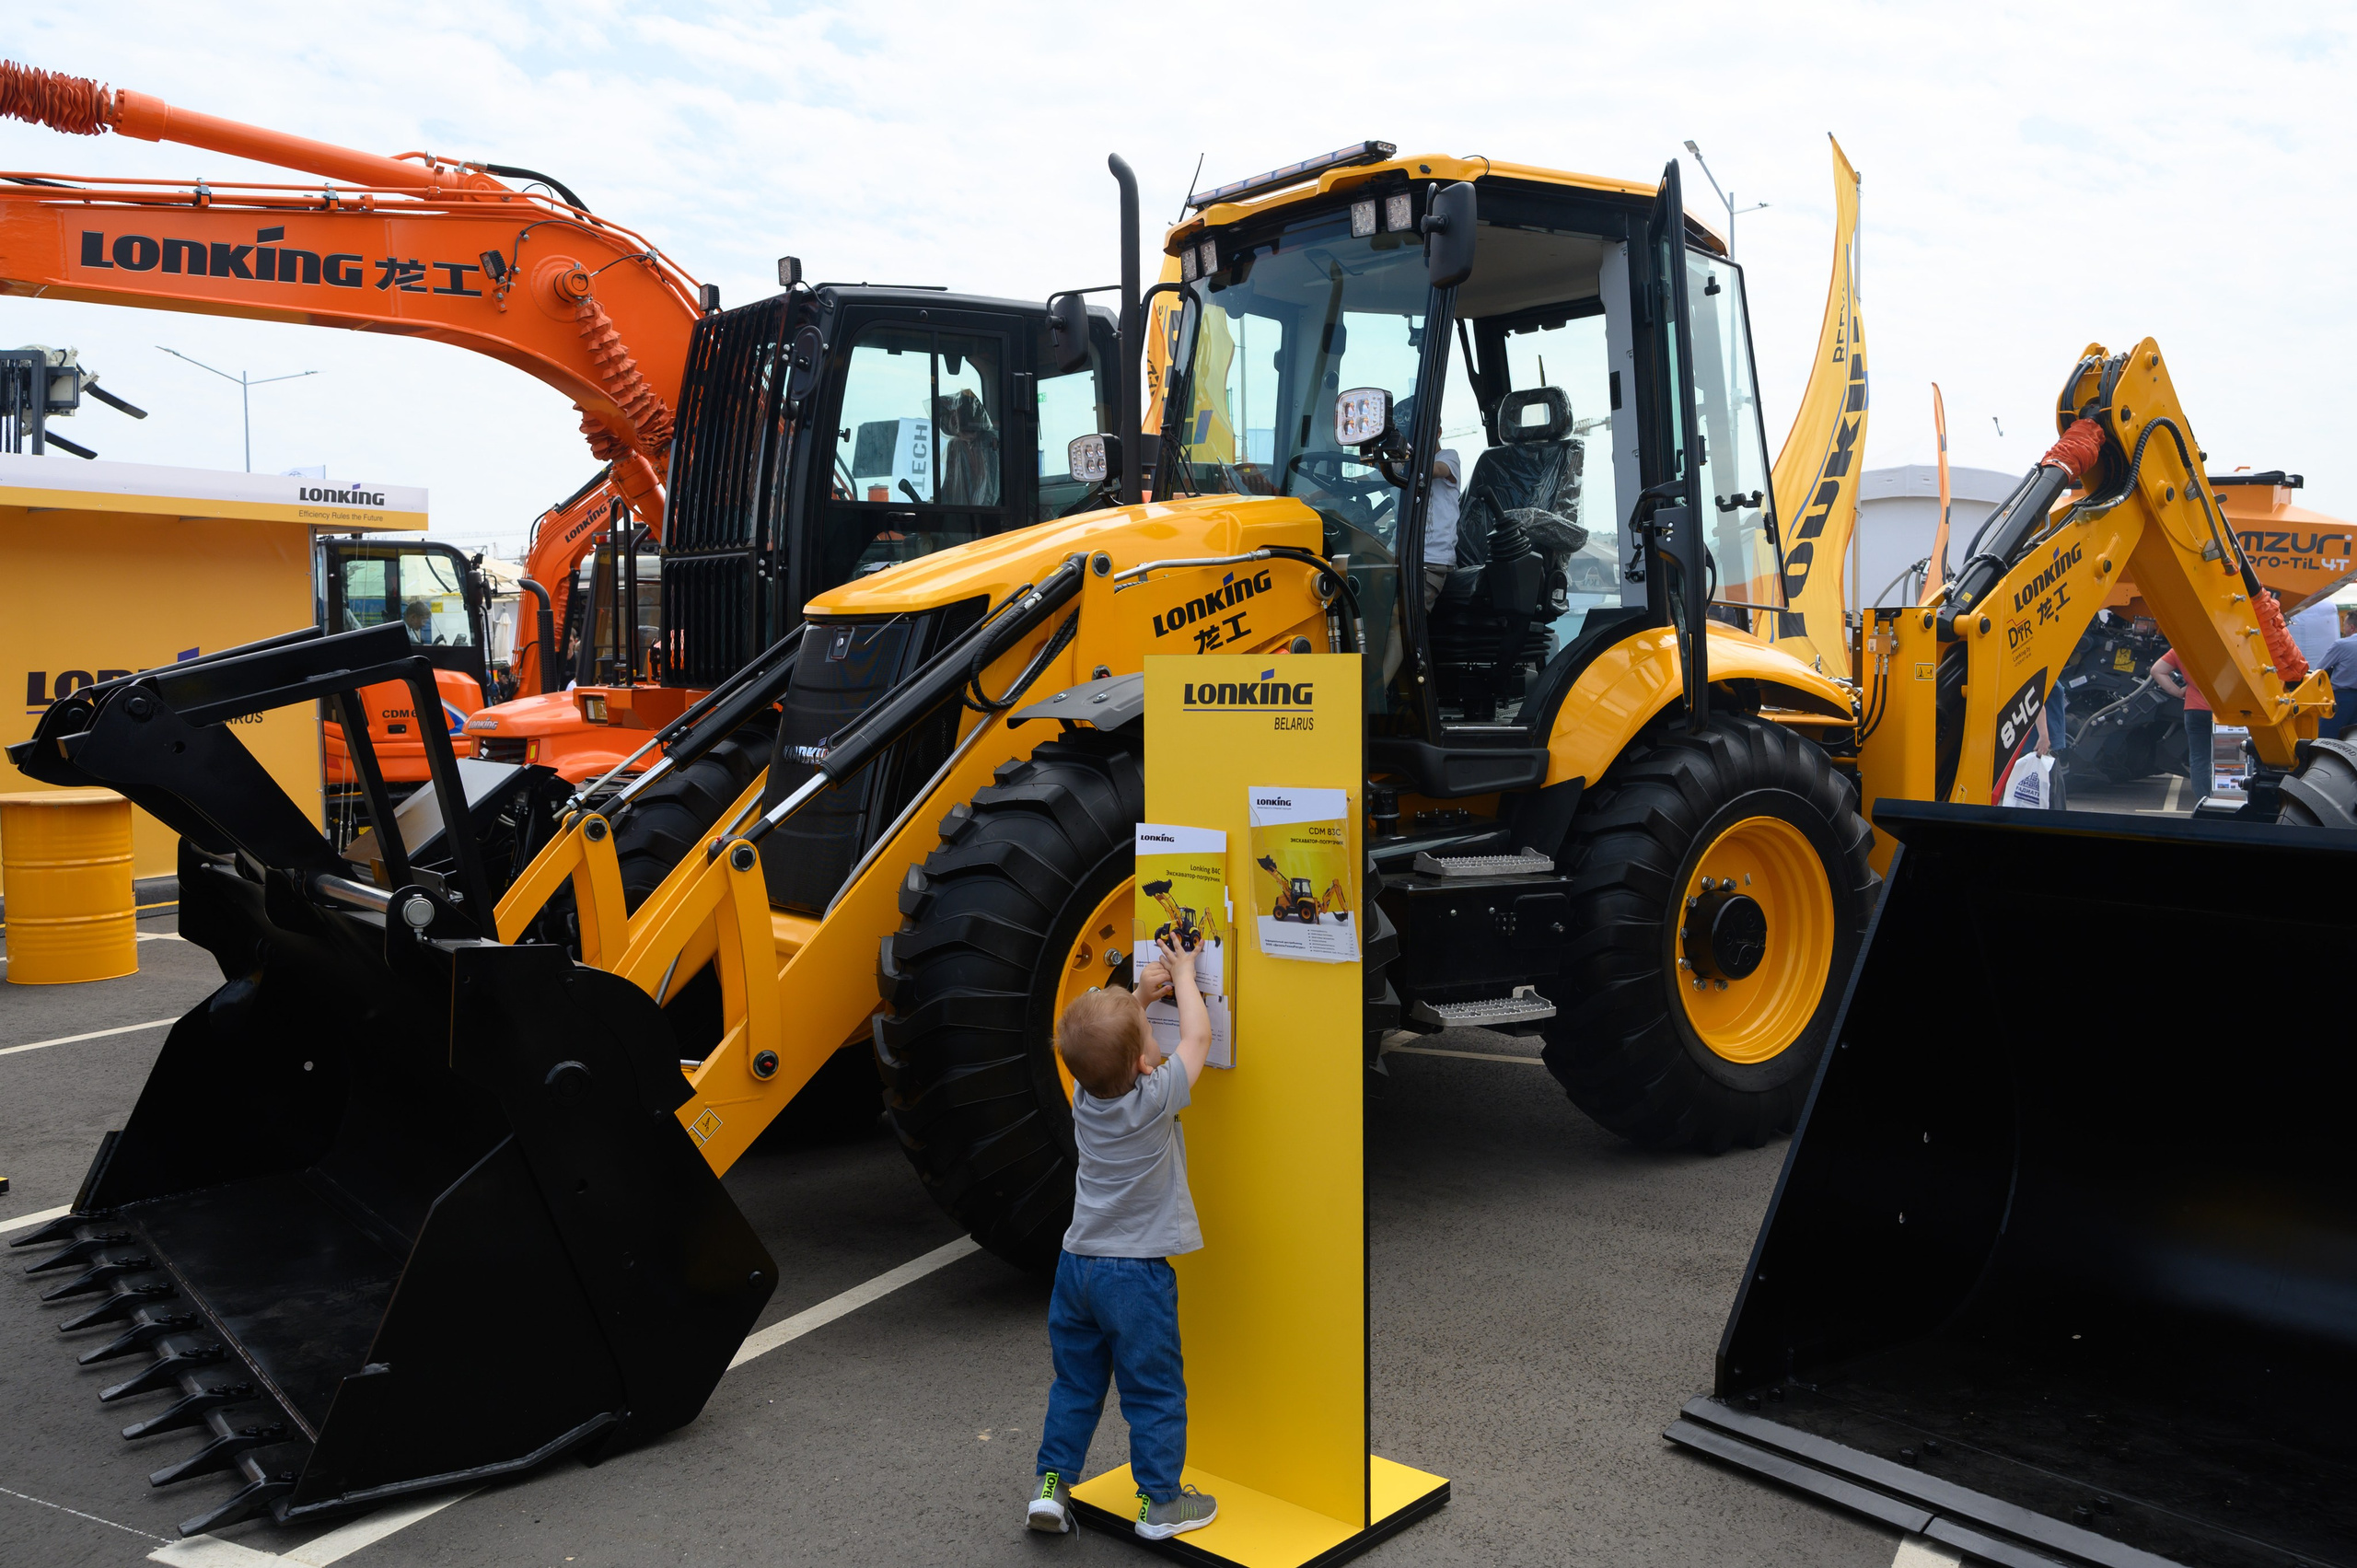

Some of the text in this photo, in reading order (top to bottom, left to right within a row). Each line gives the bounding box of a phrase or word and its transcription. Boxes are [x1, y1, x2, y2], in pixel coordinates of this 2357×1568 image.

[374, 256, 482, 298] 龙工
[298, 509, 331, 521] Efficiency
[331, 511, 350, 520] Rules
[363, 513, 384, 522] Future
[2321, 558, 2350, 571] 4T
[2037, 582, 2071, 626] 龙工
[1193, 610, 1252, 655] 龙工
[225, 711, 264, 726] ARUS
[382, 710, 410, 718] CDM
[2001, 685, 2040, 749] 84C
[1274, 716, 1314, 731] BELARUS
[1308, 827, 1341, 837] CDM 83C
[1166, 870, 1221, 882] Экскаватор-погрузчик
[1190, 865, 1211, 875] Lonking
